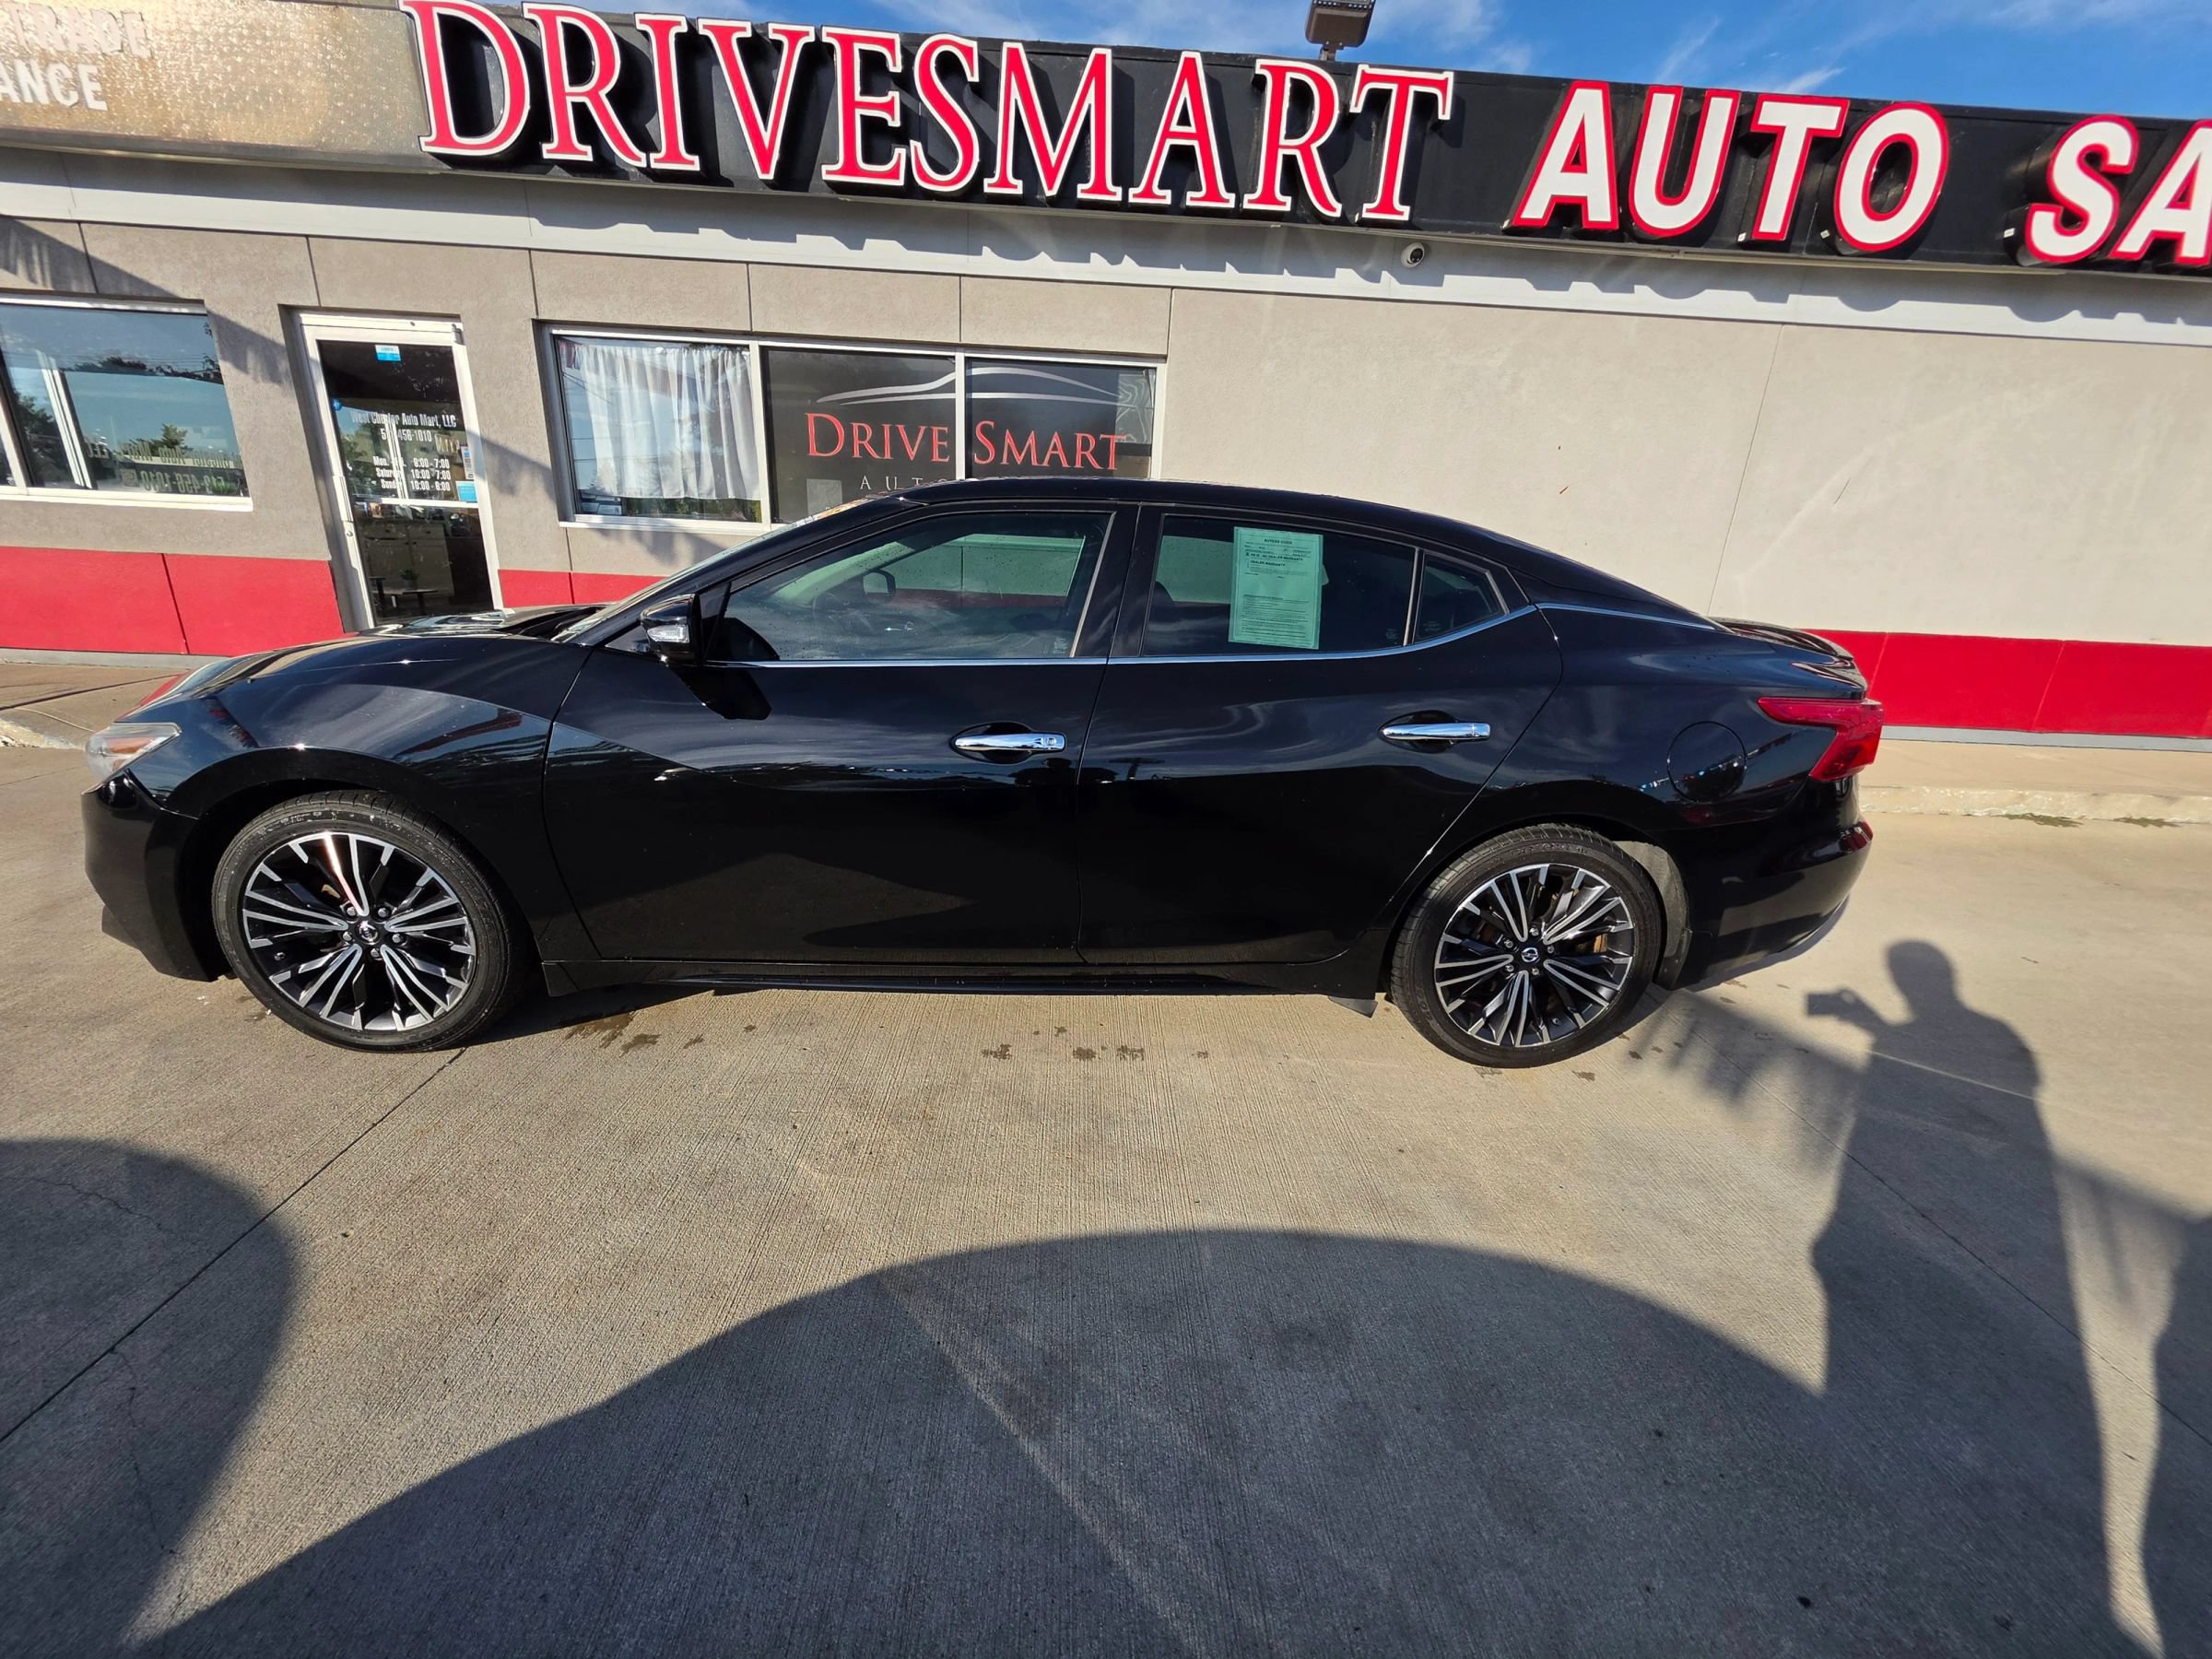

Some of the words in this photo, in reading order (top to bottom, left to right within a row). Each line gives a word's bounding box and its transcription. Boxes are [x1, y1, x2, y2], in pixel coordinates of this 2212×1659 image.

[398, 0, 1454, 222] DRIVESMART
[1510, 79, 1949, 253] AUTO
[2027, 113, 2212, 265] SA
[350, 411, 371, 424] West
[402, 413, 418, 426] Auto
[442, 415, 457, 428] LLC
[380, 428, 432, 442] 5456-1010
[805, 412, 950, 463] DRIVE
[973, 420, 1126, 470] SMART
[372, 456, 389, 466] Mon.
[433, 458, 450, 469] 7:00
[435, 469, 451, 480] 7:00
[860, 475, 948, 491] AUT
